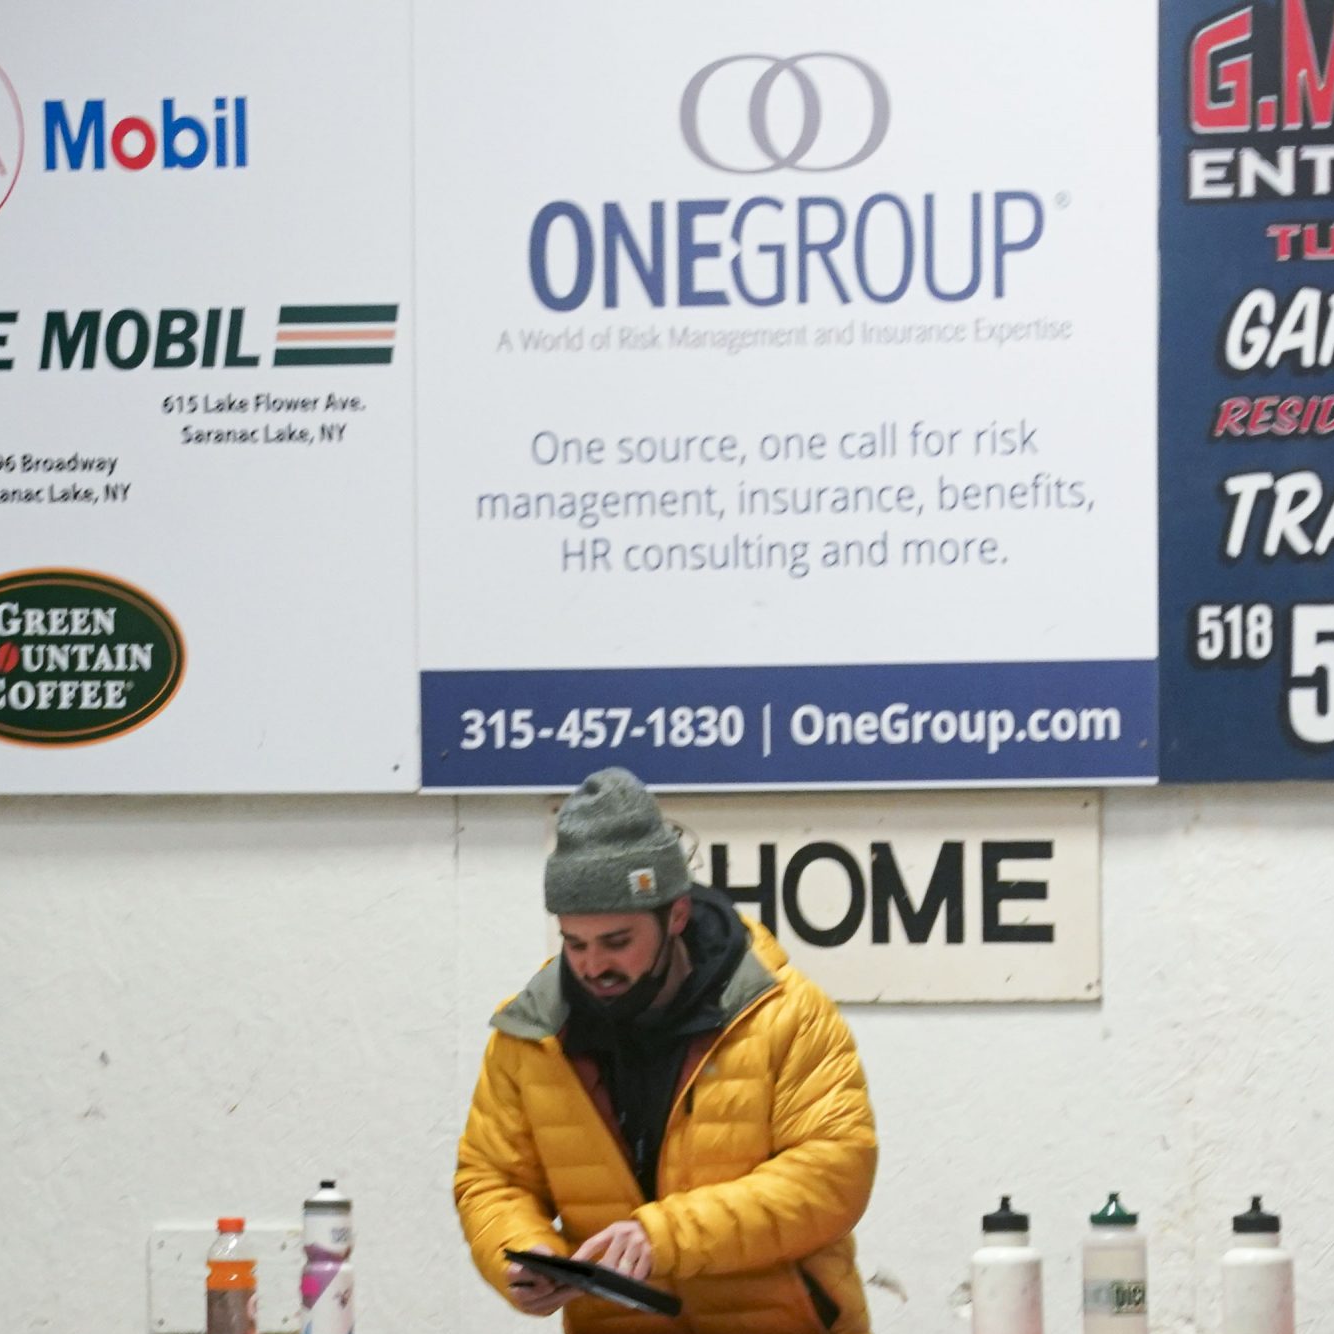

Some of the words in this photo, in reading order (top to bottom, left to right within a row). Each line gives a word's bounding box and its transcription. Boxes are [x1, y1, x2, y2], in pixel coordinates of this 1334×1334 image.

[42, 95, 249, 173] Mobil
[527, 190, 1045, 314] ONEGROUP
[37, 306, 261, 372] MOBIL
[495, 329, 514, 353] A
[518, 327, 584, 353] World
[589, 325, 612, 352] of
[618, 325, 661, 351] Risk
[668, 325, 807, 356] Management
[814, 319, 855, 347] and
[860, 321, 967, 345] Insurance
[973, 317, 1073, 348] Expertise
[161, 395, 199, 415] 615
[203, 393, 250, 414] Lake
[253, 392, 320, 413] Flower
[324, 392, 366, 412] Ave.
[181, 424, 259, 445] Saranac
[263, 423, 315, 445] Lake,
[319, 423, 347, 443] NY
[531, 430, 606, 466] One
[617, 435, 747, 466] source,
[759, 432, 827, 462] one
[838, 422, 897, 460] call
[909, 420, 962, 458] for
[974, 419, 1038, 456] risk
[20, 452, 119, 477] Broadway
[48, 482, 100, 505] Lake,
[103, 482, 132, 502] NY
[476, 486, 725, 530] management,
[738, 480, 924, 517] insurance,
[938, 472, 1095, 513] benefits,
[562, 537, 612, 572] HR
[623, 533, 811, 579] consulting
[820, 530, 889, 568] and
[902, 537, 1008, 566] more.
[1198, 604, 1273, 660] 518
[460, 705, 745, 750] 315-457-1830
[790, 702, 1121, 754] OneGroup.com
[707, 836, 1057, 950] HOME
